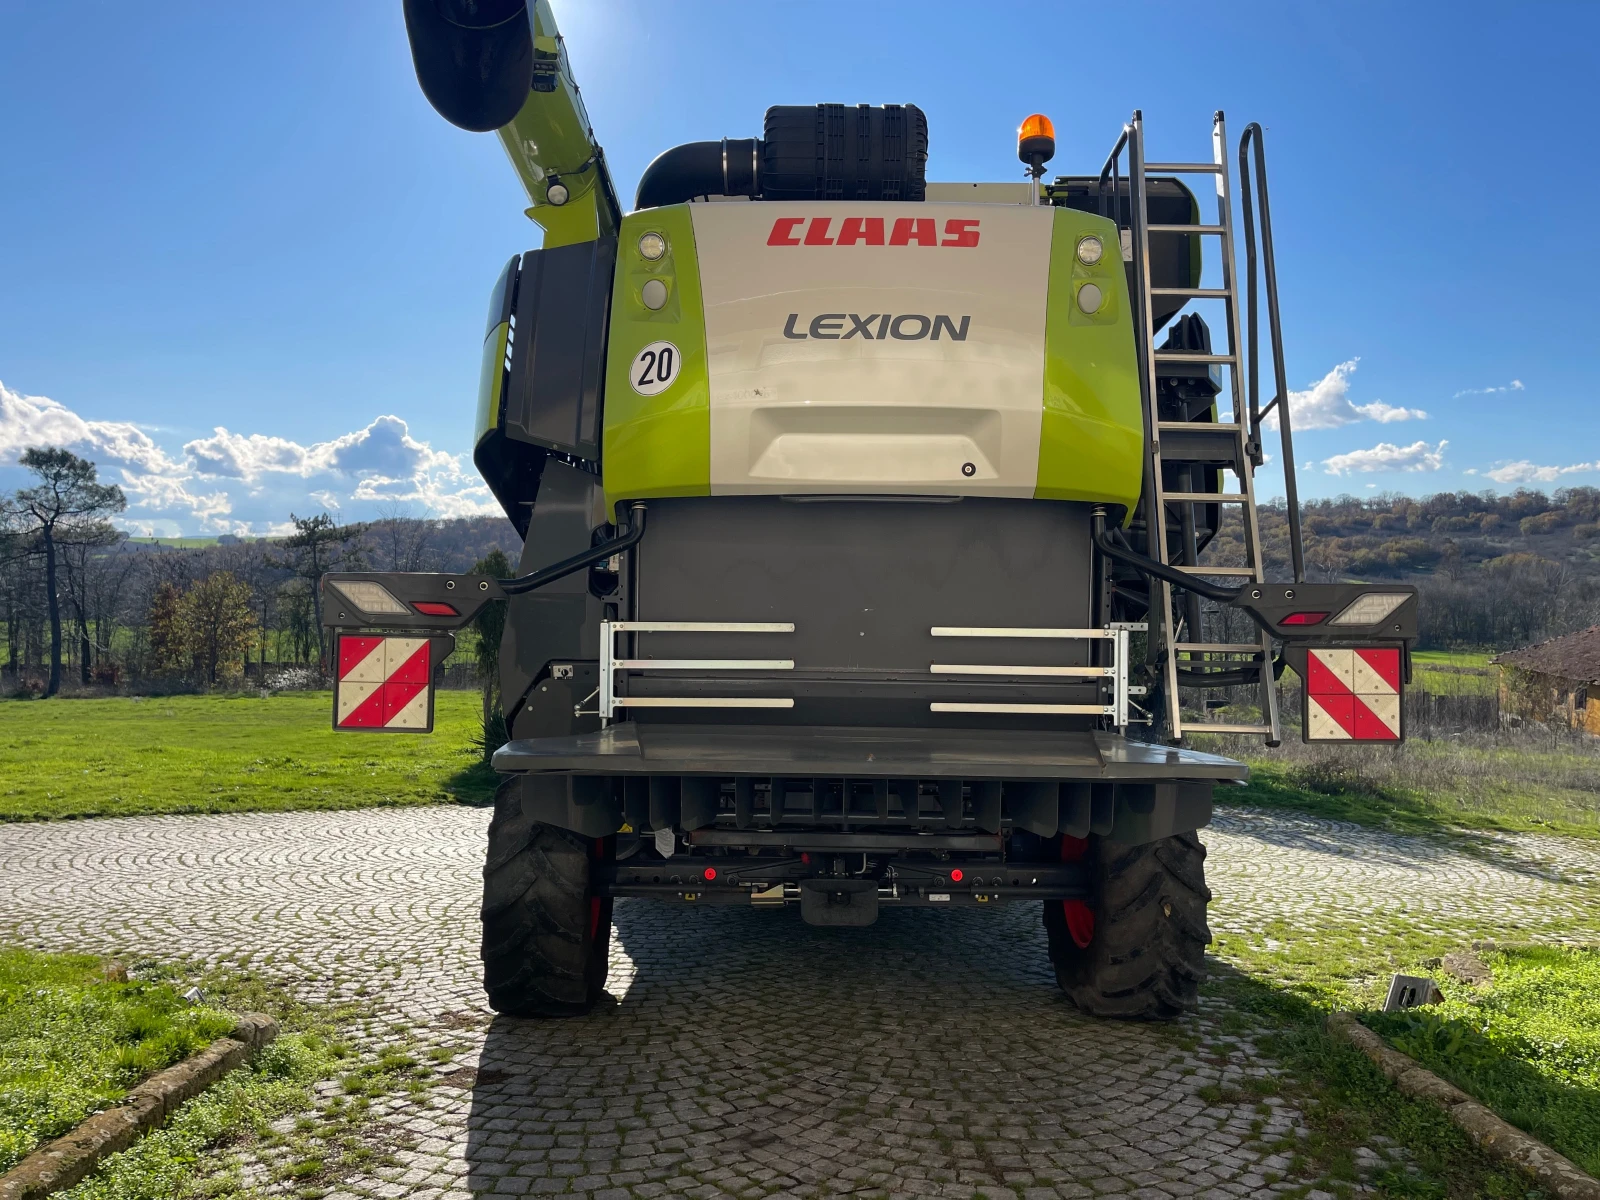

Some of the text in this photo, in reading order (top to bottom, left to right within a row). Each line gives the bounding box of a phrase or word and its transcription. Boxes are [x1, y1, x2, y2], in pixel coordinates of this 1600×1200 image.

[766, 217, 981, 248] CLAAS
[783, 313, 971, 341] LEXION
[637, 347, 673, 386] 20
